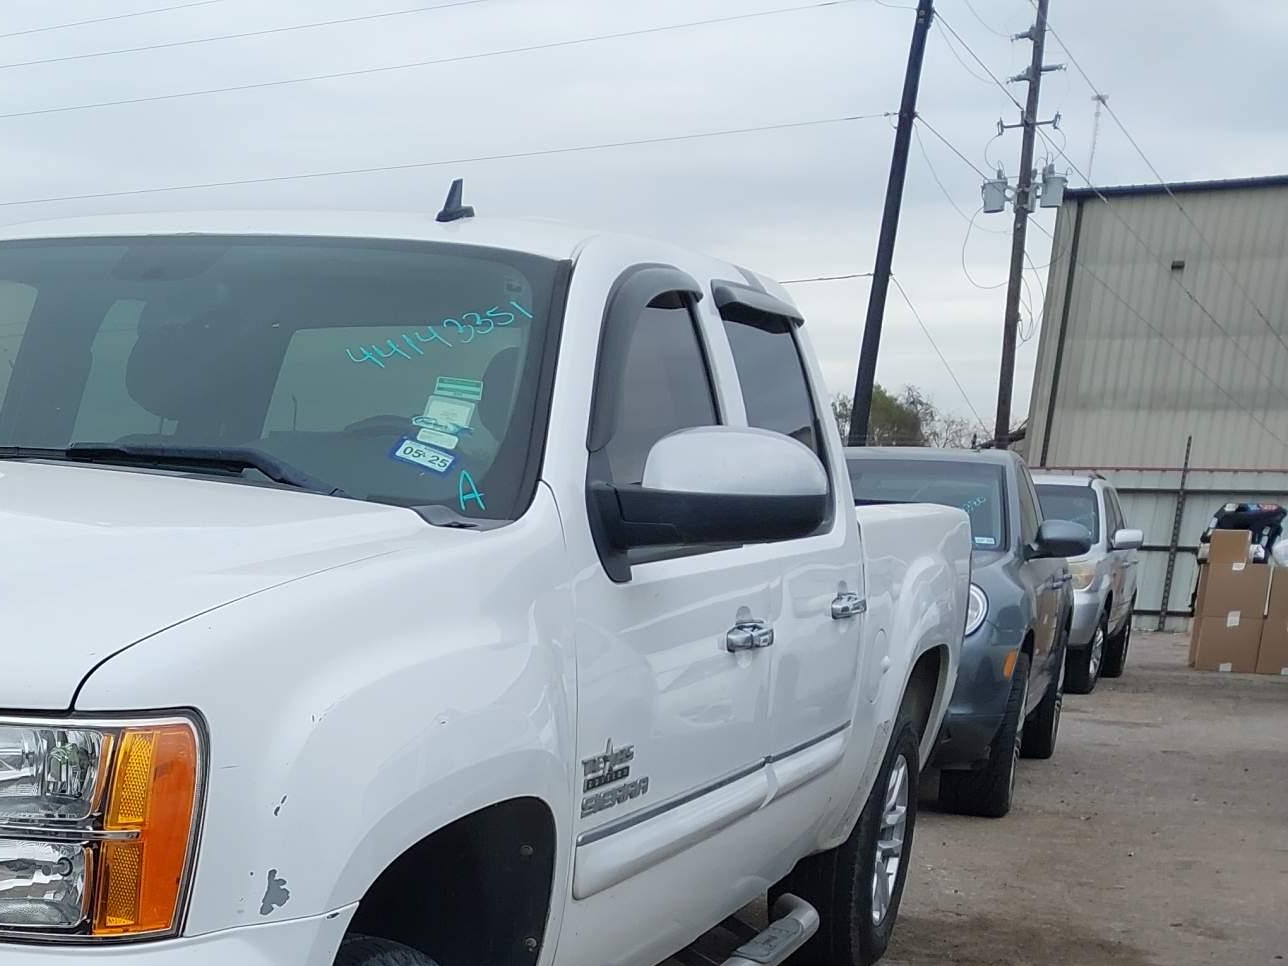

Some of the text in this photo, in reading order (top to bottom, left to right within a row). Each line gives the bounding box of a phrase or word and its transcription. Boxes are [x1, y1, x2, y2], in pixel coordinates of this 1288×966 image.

[345, 300, 534, 369] 44143351
[402, 445, 450, 468] 05 25
[457, 469, 487, 512] A
